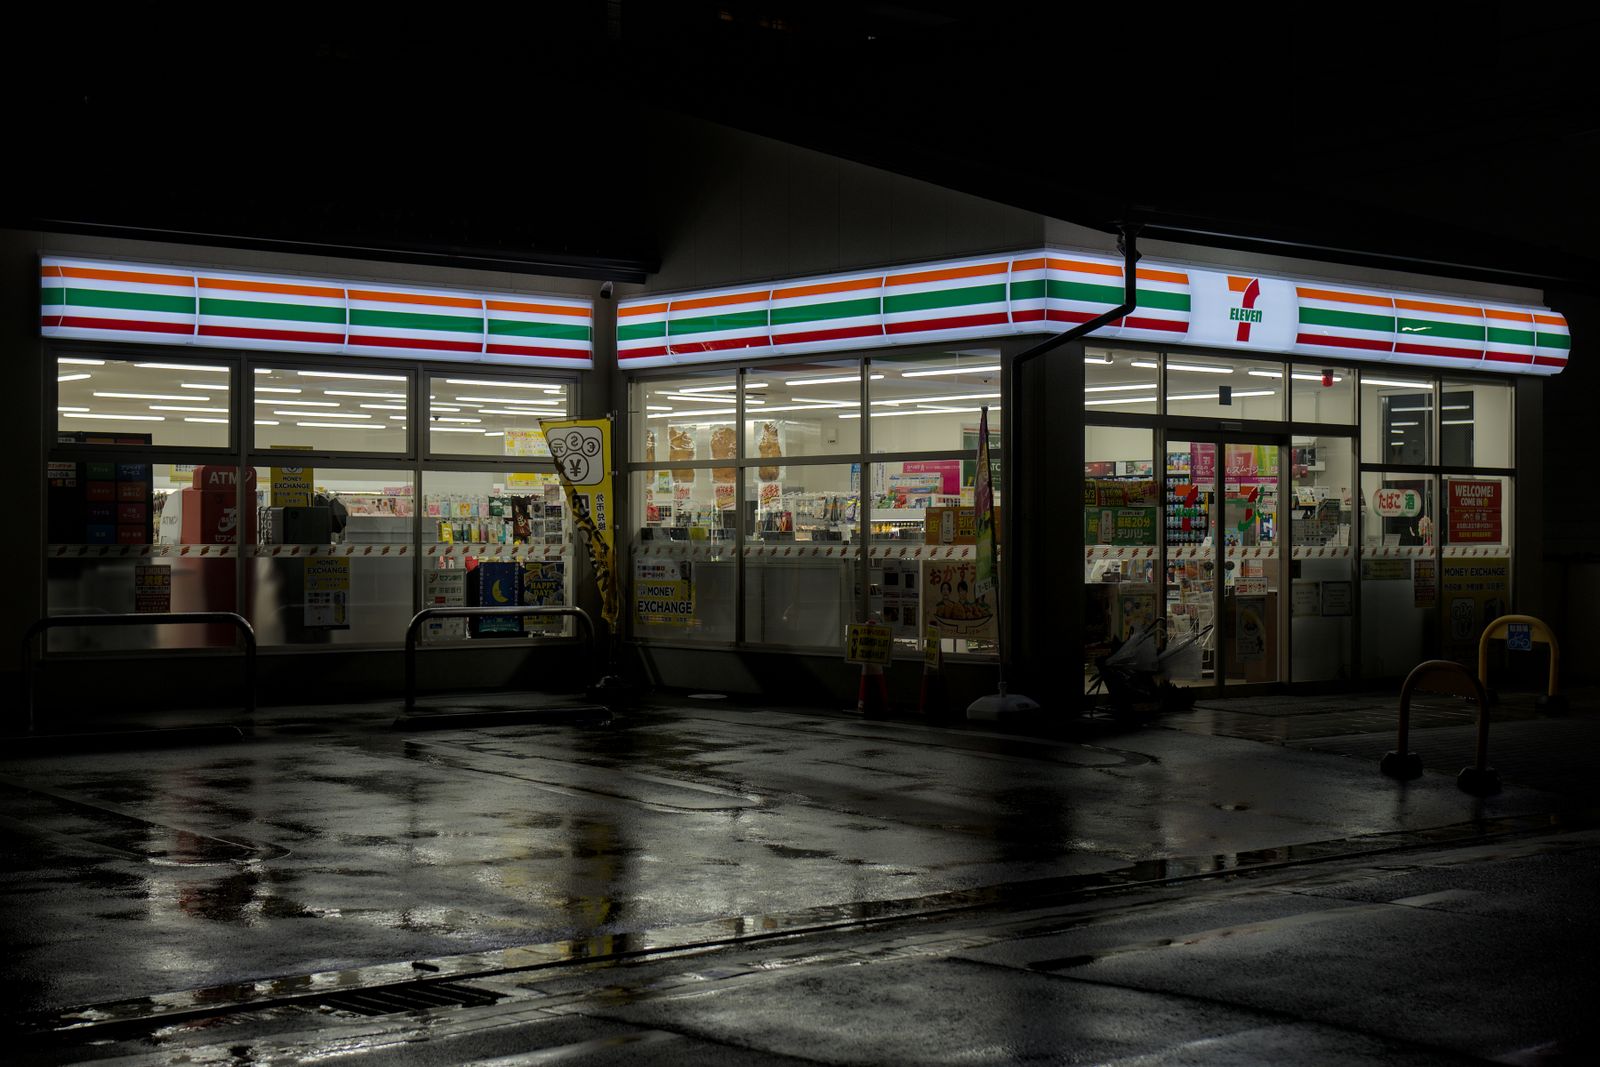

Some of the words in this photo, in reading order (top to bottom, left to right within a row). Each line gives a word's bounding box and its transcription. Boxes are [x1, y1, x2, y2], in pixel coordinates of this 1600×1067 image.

[1454, 485, 1494, 498] WELCOME!
[1379, 494, 1401, 510] たばこ
[1405, 494, 1415, 510] 酒
[1444, 567, 1468, 576] MONEY
[1471, 567, 1505, 576] EXCHANGE
[648, 586, 675, 596] MONEY
[638, 600, 692, 614] EXCHANGE
